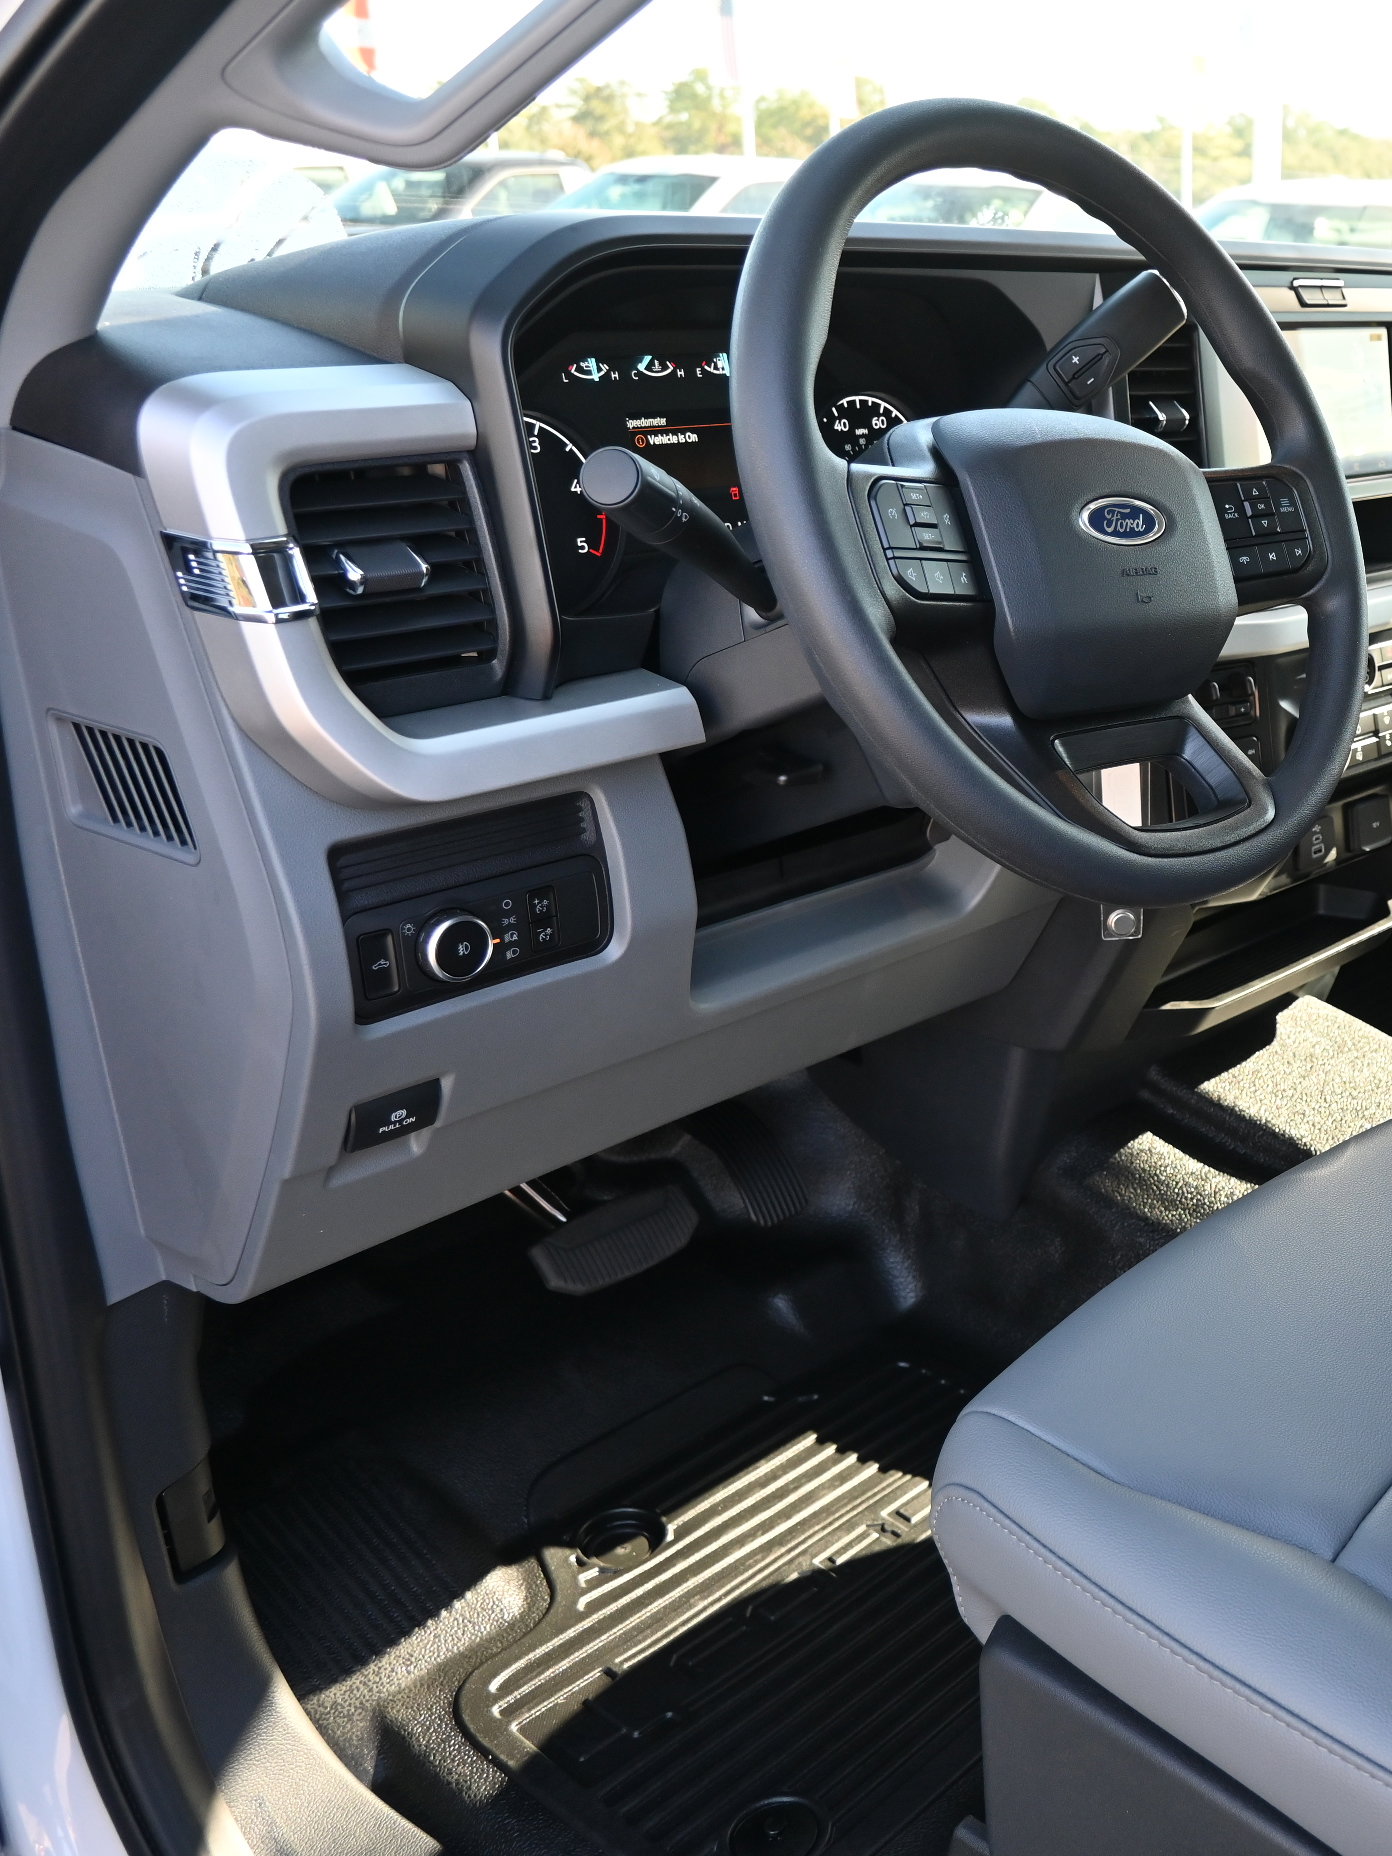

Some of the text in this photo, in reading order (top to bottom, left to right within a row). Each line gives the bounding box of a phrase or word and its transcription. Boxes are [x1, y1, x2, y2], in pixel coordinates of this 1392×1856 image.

[561, 373, 569, 382] L
[610, 371, 619, 380] H
[631, 370, 639, 380] C
[676, 368, 685, 378] H
[696, 368, 703, 378] E
[834, 418, 849, 432] 40
[871, 416, 887, 429] 60
[855, 428, 869, 436] MPH
[529, 436, 541, 453] 3
[647, 432, 698, 446] Vehicle Is On
[571, 479, 582, 494] 4
[1103, 507, 1146, 533] Ford
[1224, 512, 1240, 520] BACK
[576, 537, 589, 554] 5
[378, 1116, 416, 1134] PULL ON
